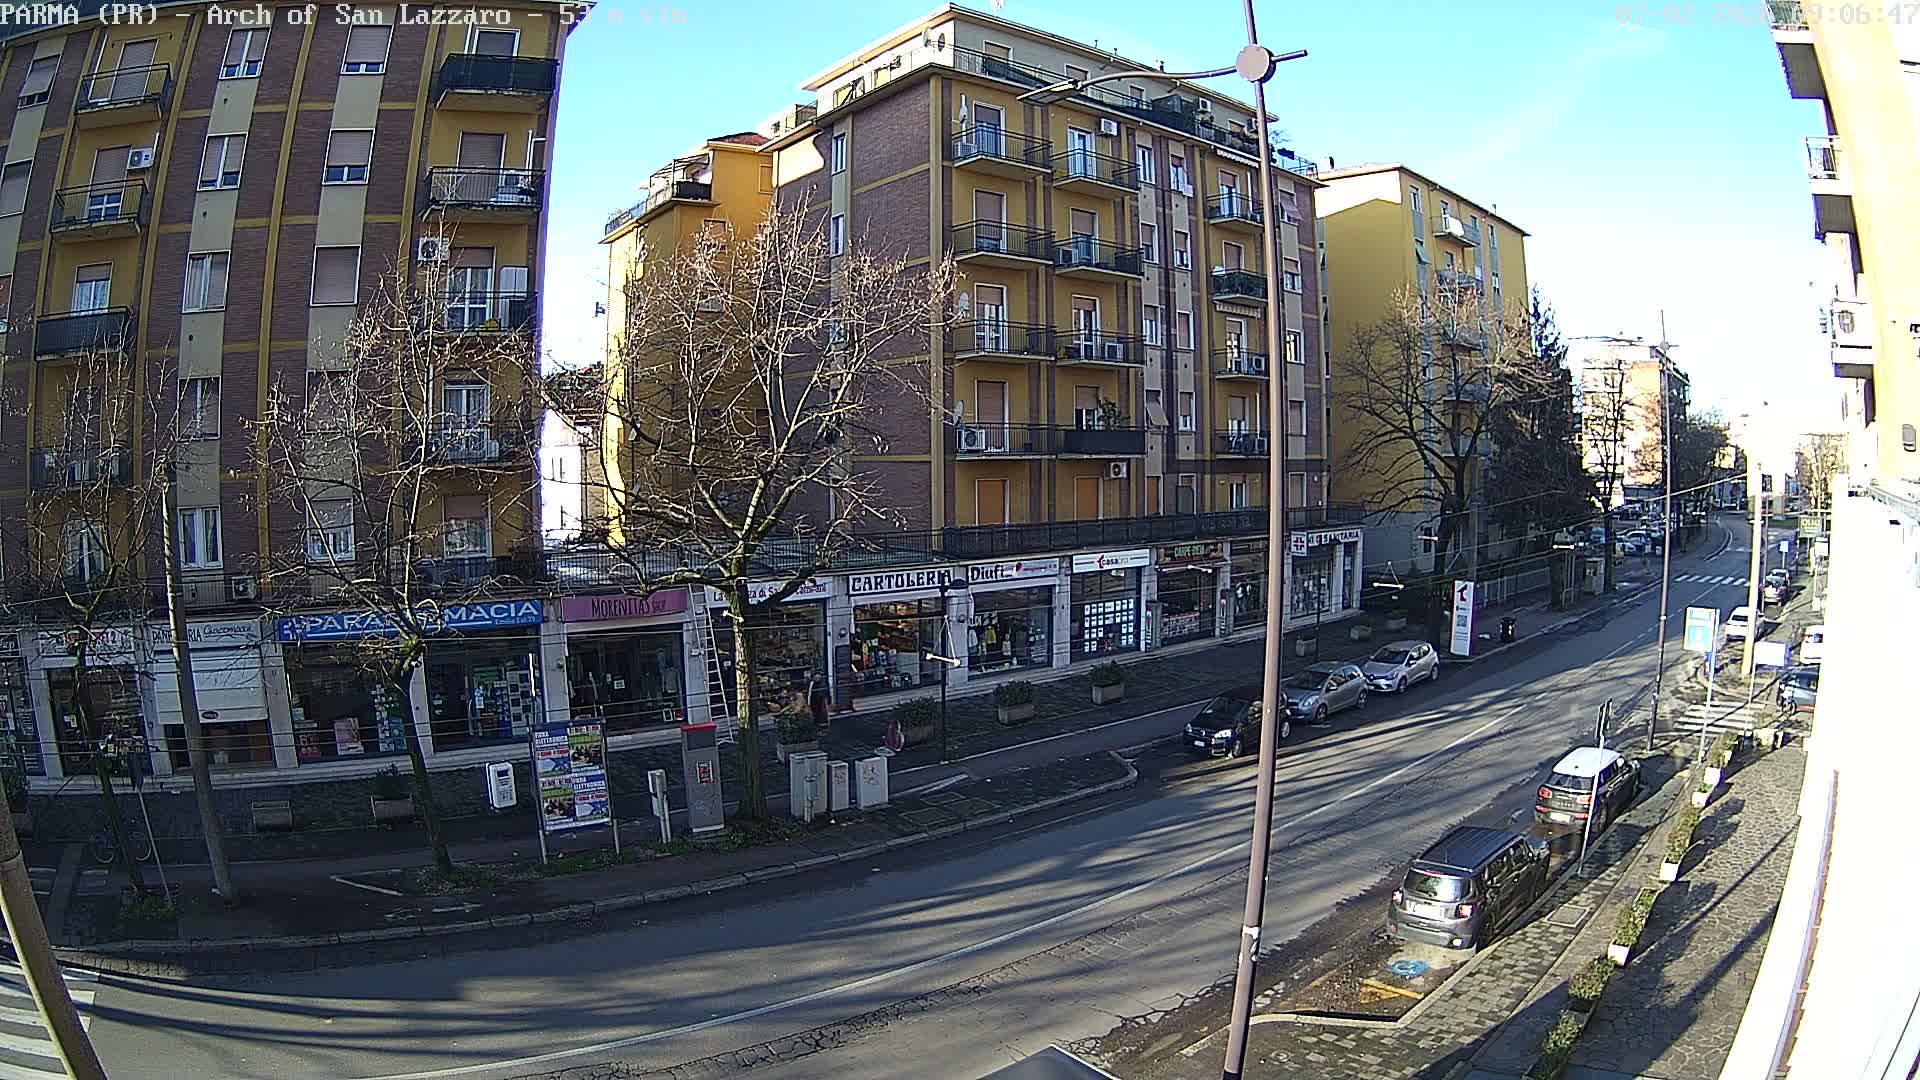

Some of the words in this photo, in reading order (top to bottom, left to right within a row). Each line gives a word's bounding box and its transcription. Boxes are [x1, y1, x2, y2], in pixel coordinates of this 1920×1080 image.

[851, 570, 952, 592] CARTOLERIA
[305, 602, 538, 632] PARAMACIA
[591, 597, 650, 617] MORENITAS
